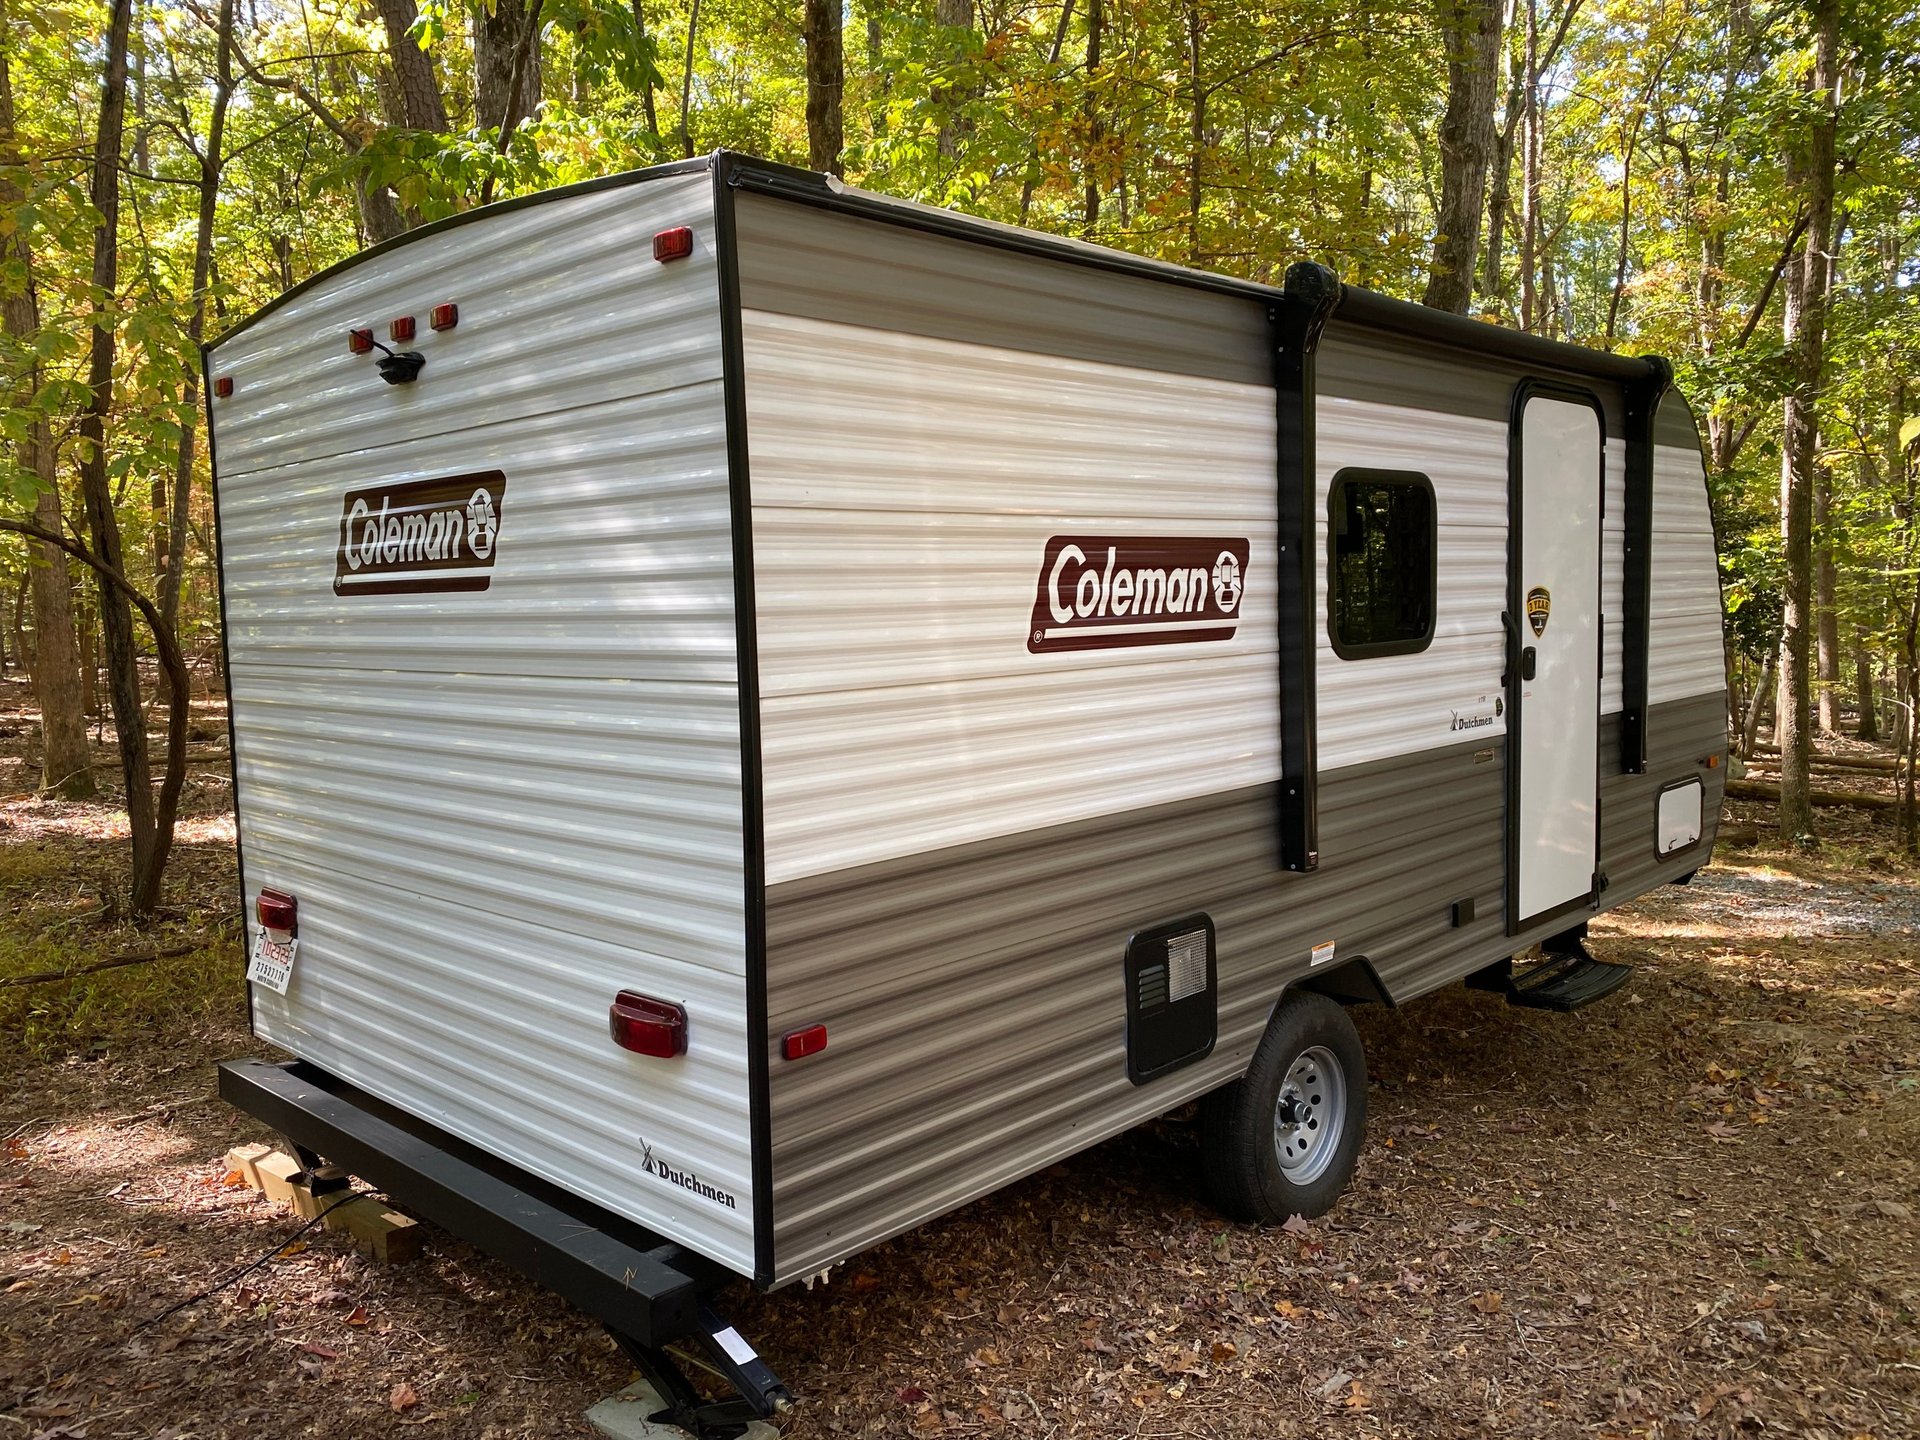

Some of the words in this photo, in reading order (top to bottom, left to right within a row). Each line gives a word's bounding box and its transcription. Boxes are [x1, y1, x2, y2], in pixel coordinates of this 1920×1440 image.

[345, 496, 464, 570] Coleman
[1048, 544, 1208, 624] Coleman
[1459, 716, 1493, 730] Dutchmen
[658, 1159, 736, 1209] Dutchmen
